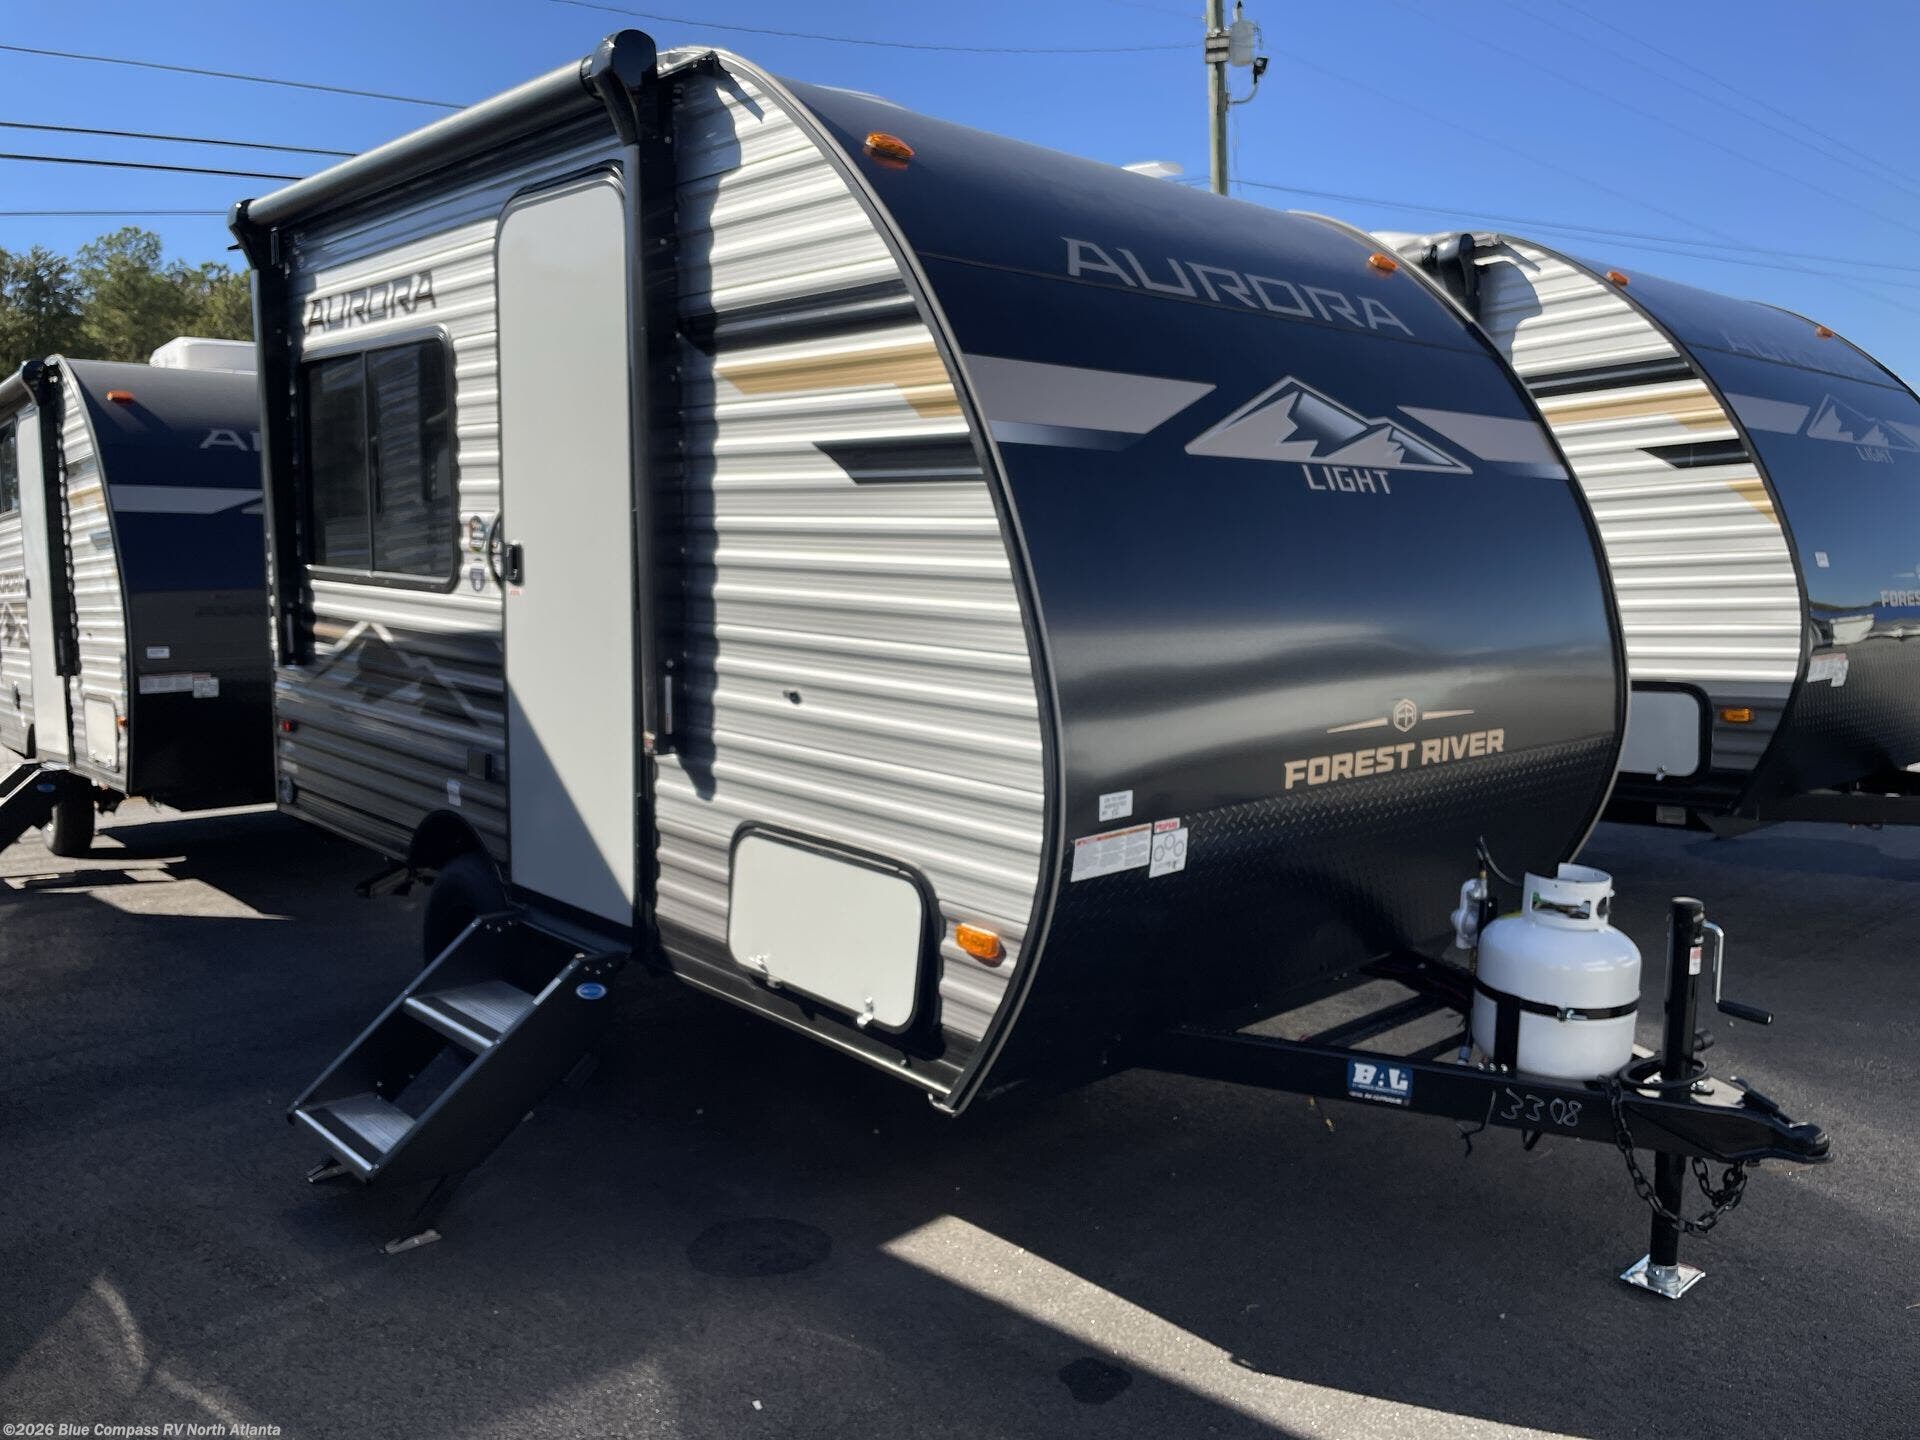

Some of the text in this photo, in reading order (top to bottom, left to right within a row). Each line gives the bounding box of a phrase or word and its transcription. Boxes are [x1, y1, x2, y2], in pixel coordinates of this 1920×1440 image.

[302, 270, 437, 336] AURORA
[1060, 236, 1415, 336] AURORA
[1301, 463, 1391, 495] LIGHT
[1284, 727, 1505, 790] FOREST RIVER
